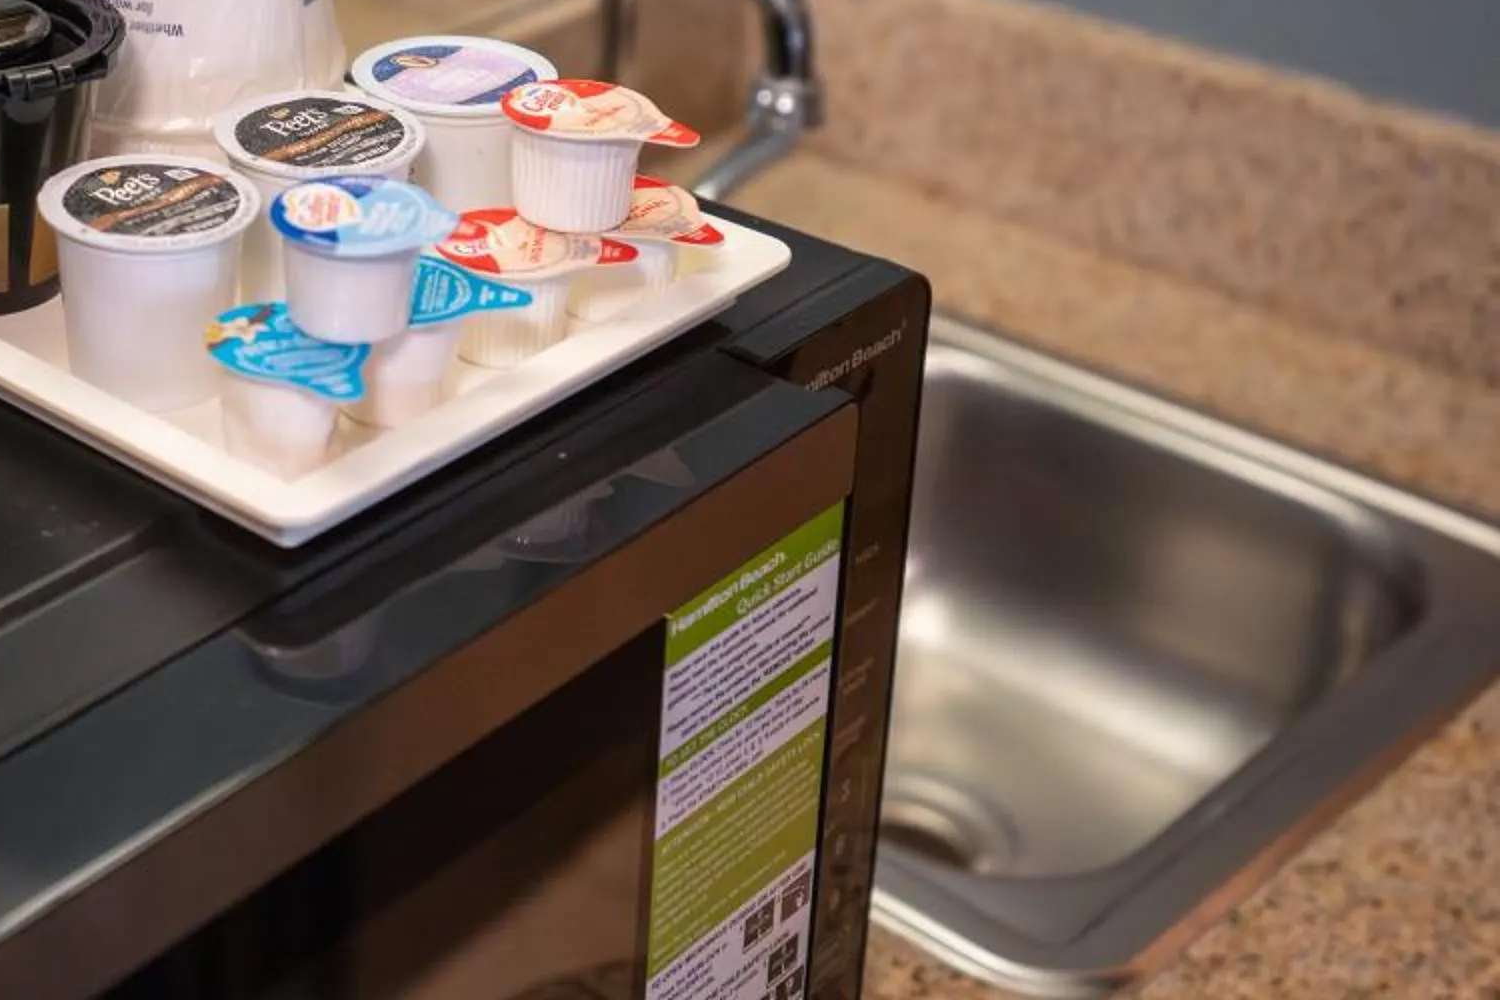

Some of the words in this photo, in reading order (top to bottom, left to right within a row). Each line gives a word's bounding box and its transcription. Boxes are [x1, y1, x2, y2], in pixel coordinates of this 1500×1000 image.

[127, 21, 184, 38] Whether
[89, 172, 160, 206] Peet's
[851, 329, 901, 369] Beach
[671, 582, 738, 637] Hamilton
[739, 551, 786, 591] Beach
[737, 583, 771, 614] Quick
[772, 561, 802, 585] Start
[804, 538, 838, 569] Guide
